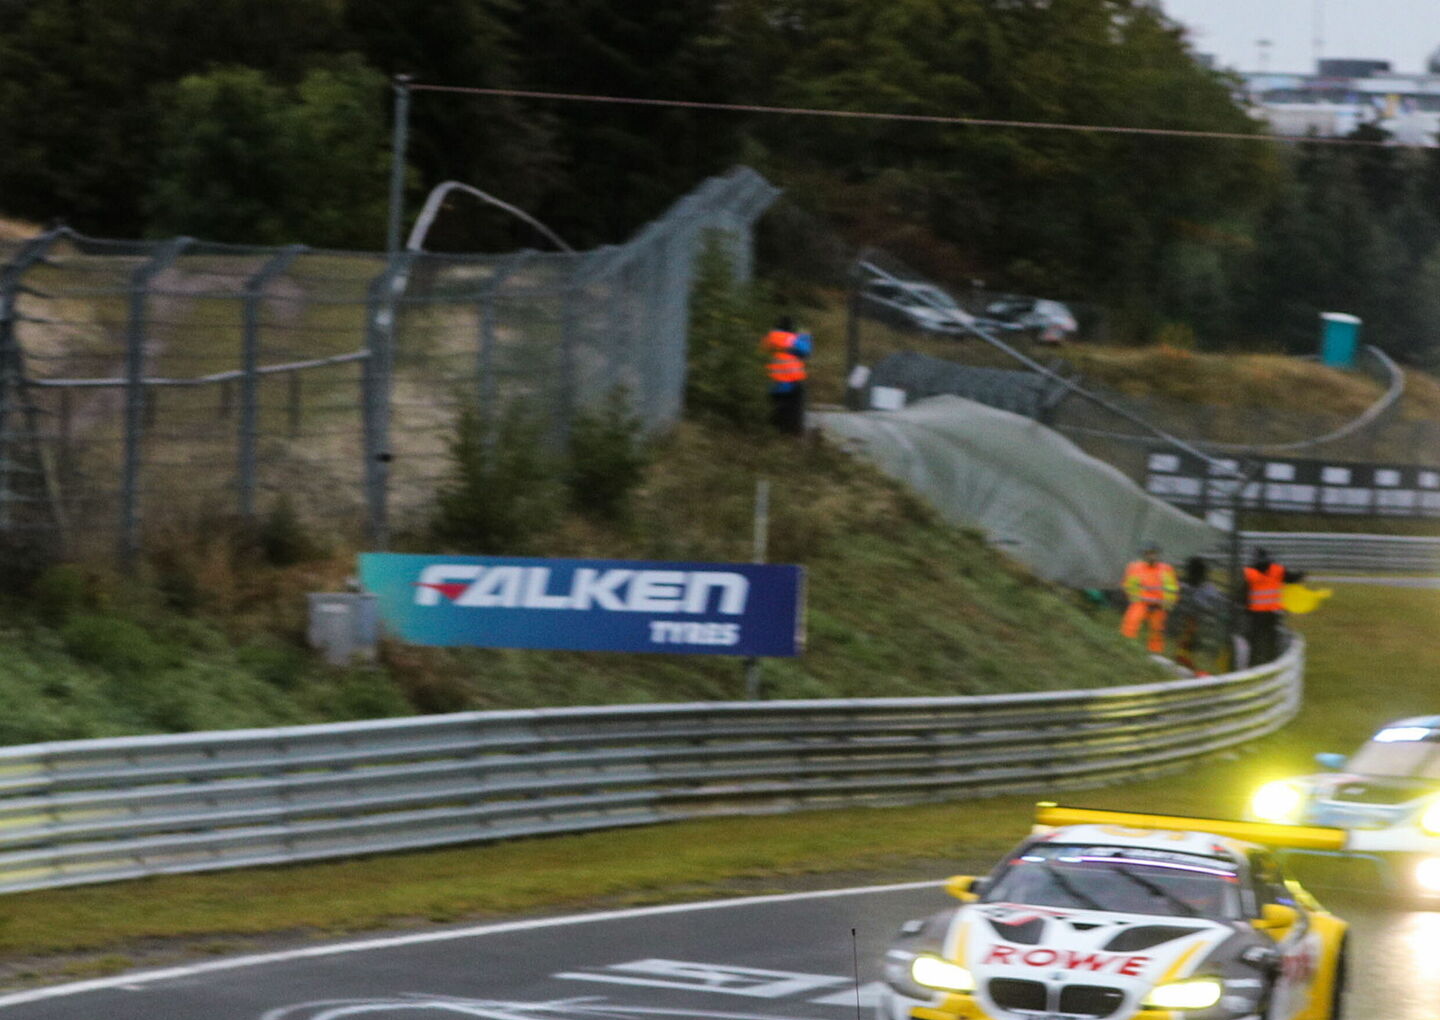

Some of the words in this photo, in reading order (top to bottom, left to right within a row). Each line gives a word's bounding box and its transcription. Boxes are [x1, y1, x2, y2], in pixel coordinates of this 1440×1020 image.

[413, 563, 750, 615] FALKEN
[649, 620, 741, 646] TYRES
[982, 943, 1153, 977] ROWE
